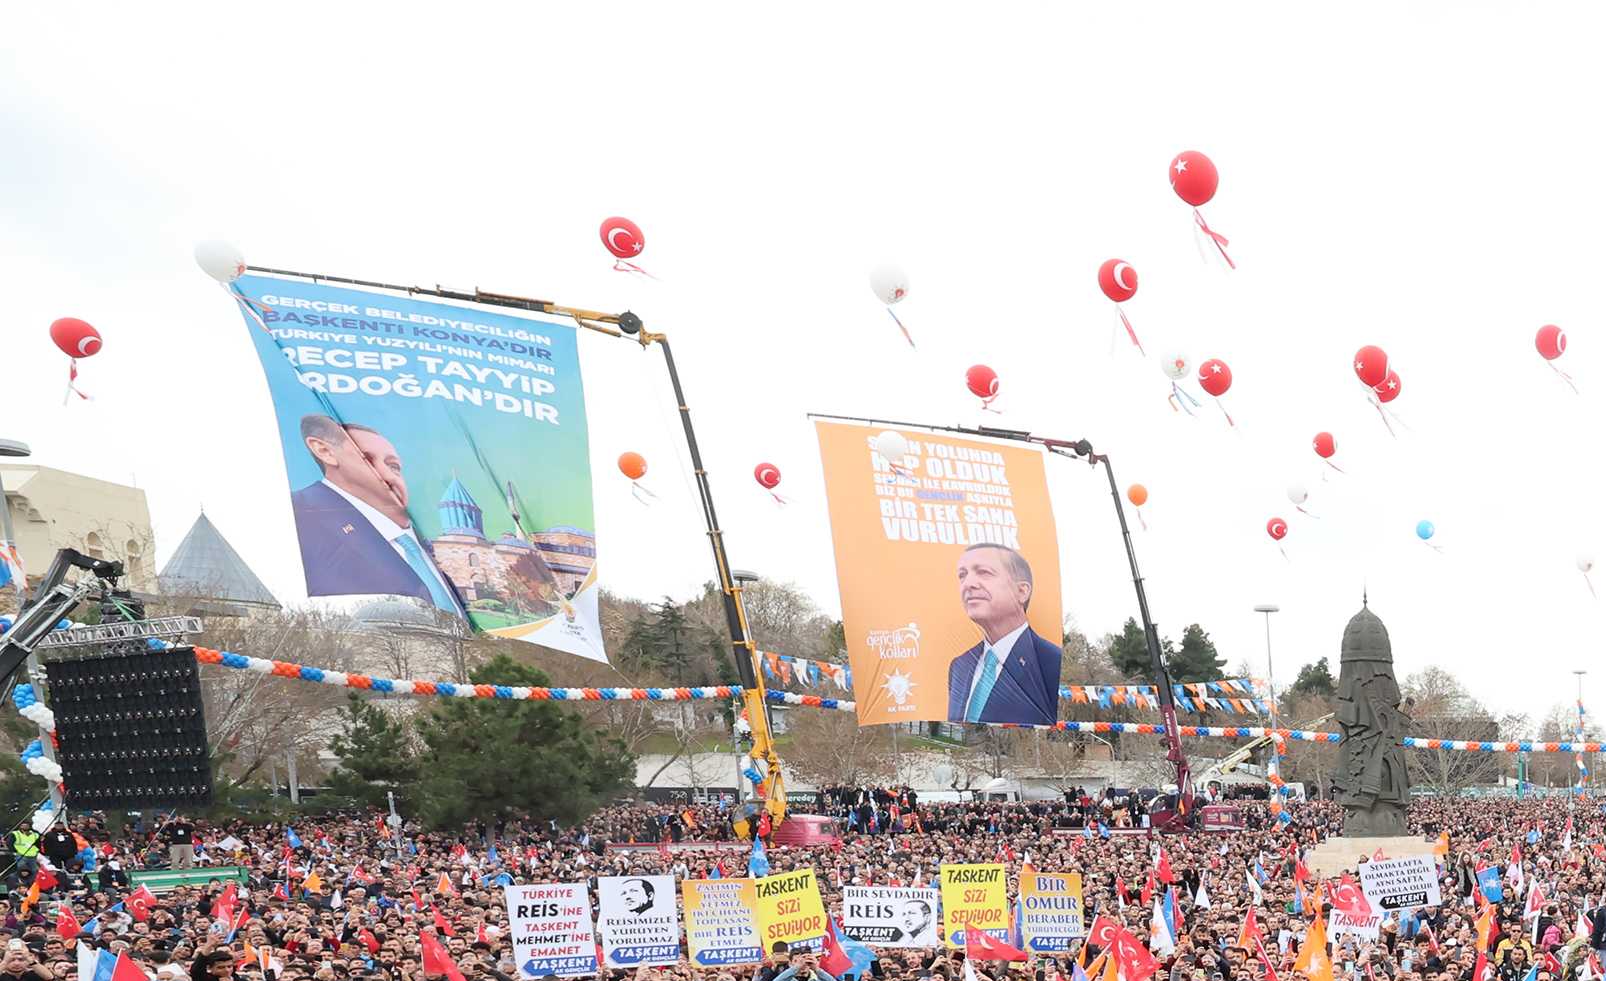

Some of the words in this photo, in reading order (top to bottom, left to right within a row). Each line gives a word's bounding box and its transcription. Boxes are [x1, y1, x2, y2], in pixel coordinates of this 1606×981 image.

[261, 295, 360, 315] GERÇEK
[296, 371, 560, 425] RDOĞAN'DIR
[926, 457, 1009, 485] OLDUK
[921, 502, 960, 522] TEK
[881, 517, 1021, 549] VURULDUK
[1370, 863, 1396, 871] SEVDA
[1398, 859, 1422, 868] LAFTA
[1365, 870, 1405, 880] OLMAKTA
[1397, 875, 1424, 884] SAFTA
[1410, 882, 1433, 891] OLUR
[872, 889, 934, 899] SEVDADIR
[849, 902, 894, 918] REİS
[1027, 914, 1080, 924] BERABER
[844, 927, 896, 939] TAŞKENT
[608, 936, 673, 945] YORULMAZ
[1036, 937, 1068, 949] TAŞKE
[530, 946, 581, 957] EMANET
[618, 946, 676, 960] TAŞKENT
[703, 948, 759, 961] TAŞKENT
[532, 957, 595, 971] TAŞKENT
